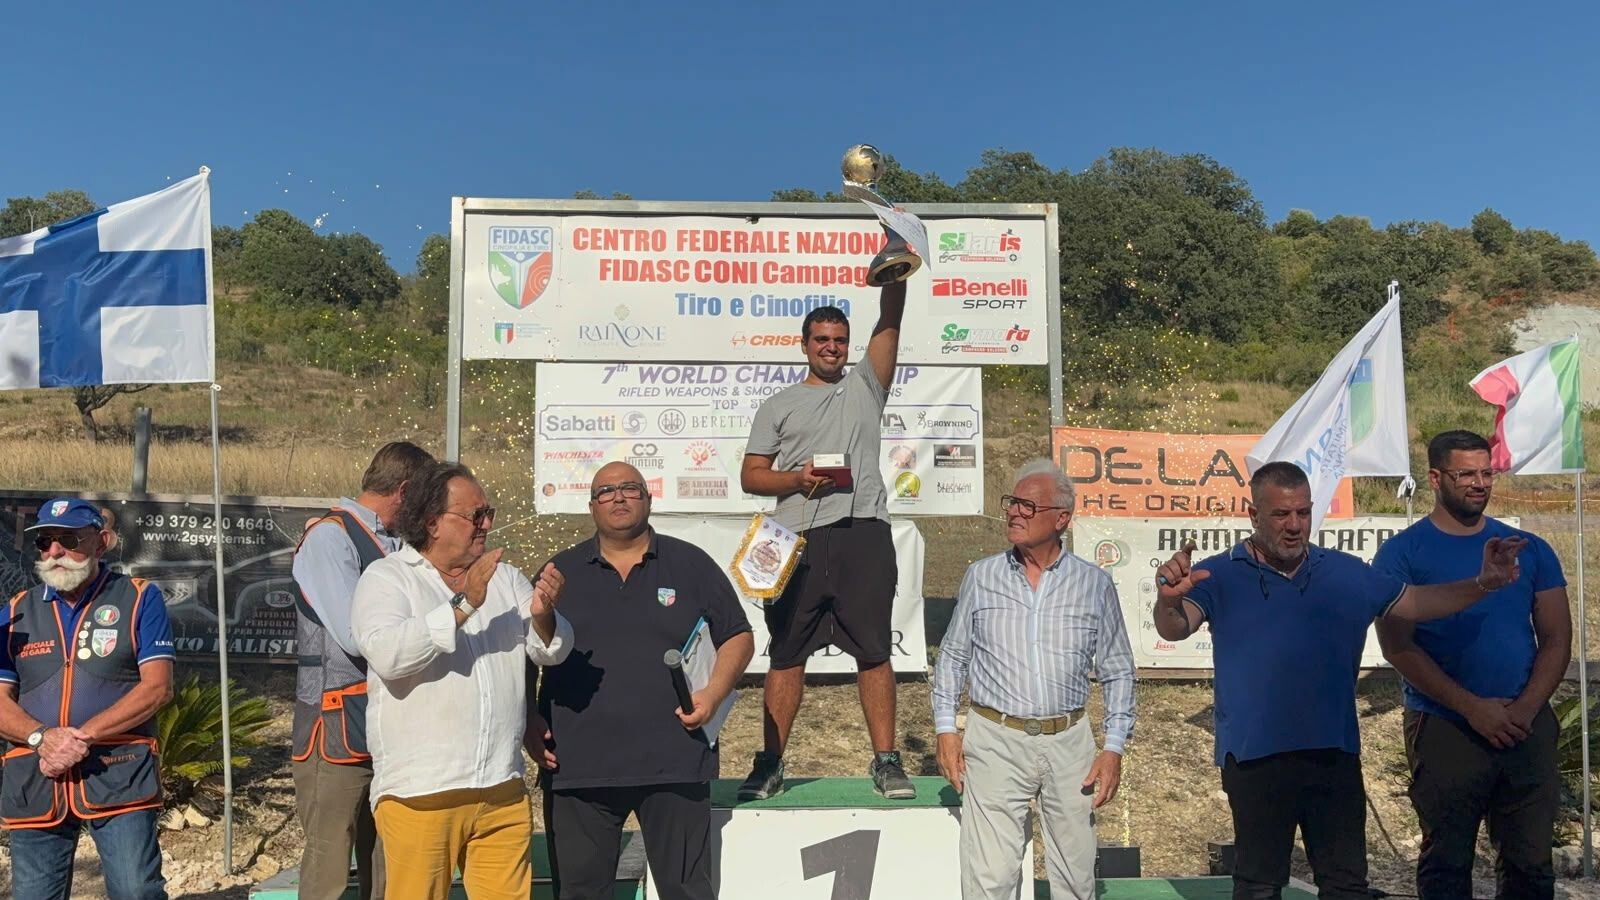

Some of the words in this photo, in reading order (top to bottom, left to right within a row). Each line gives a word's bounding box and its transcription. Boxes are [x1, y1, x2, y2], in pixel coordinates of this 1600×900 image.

[493, 229, 549, 245] FIDASC
[573, 228, 667, 252] CENTRO
[677, 229, 790, 253] FEDERALE
[797, 231, 888, 255] NAZION
[939, 232, 1022, 252] Silaris
[600, 259, 690, 283] FIDASC
[695, 259, 757, 284] CONI
[762, 261, 869, 288] Campag
[952, 278, 1028, 297] Benelli
[675, 292, 721, 316] Tiro
[730, 297, 744, 316] e
[962, 299, 1028, 309] SPORT
[750, 335, 802, 346] CRISP
[602, 363, 628, 384] 7th
[638, 366, 728, 385] WORLD
[618, 386, 660, 397] RIFLED
[665, 386, 728, 397] WEAPONS
[732, 386, 740, 396] &
[713, 400, 739, 410] TOP
[546, 415, 615, 431] Sabatti
[692, 415, 752, 428] BERETTA
[927, 419, 973, 429] BROWNING
[1076, 494, 1127, 510] HE
[1145, 494, 1253, 512] ORIGIN
[135, 515, 164, 527] +39
[169, 515, 198, 528] 379
[202, 516, 231, 529] 240
[236, 517, 274, 531] 4648
[29, 646, 52, 656] GARA
[800, 830, 881, 900] 1
